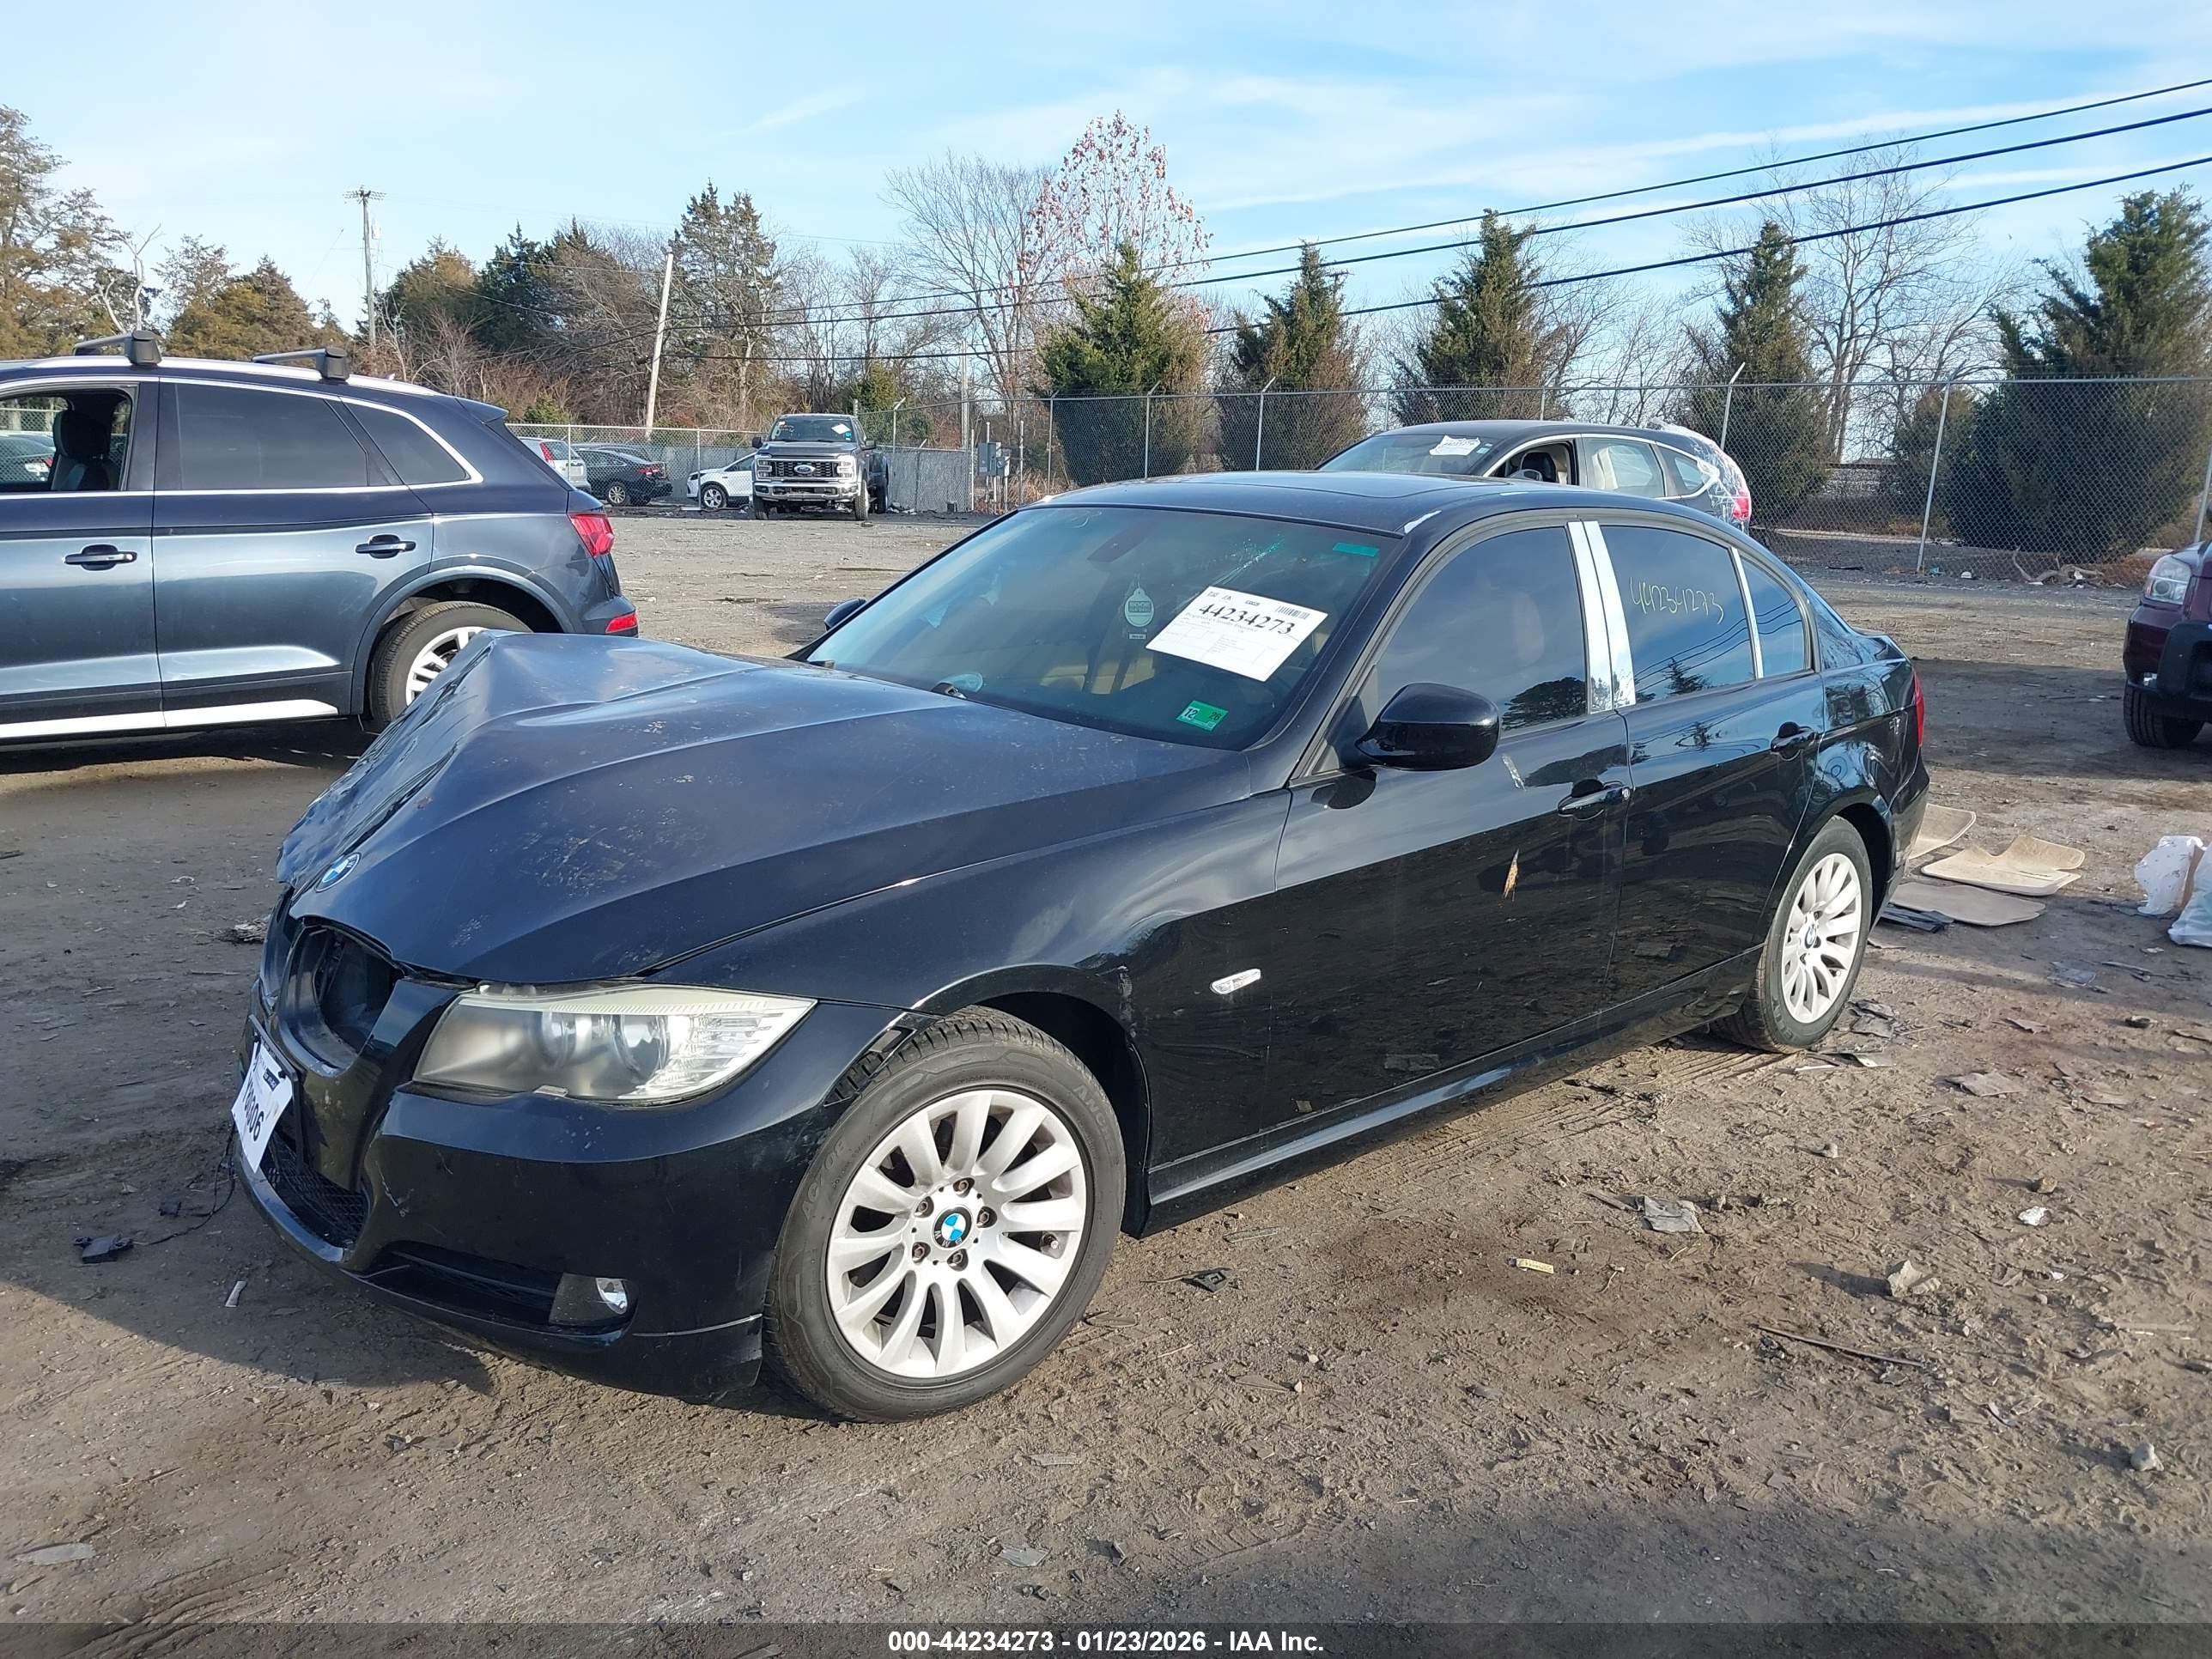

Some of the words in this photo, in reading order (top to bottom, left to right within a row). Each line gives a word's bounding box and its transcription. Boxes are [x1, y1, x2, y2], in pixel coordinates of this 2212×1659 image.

[1629, 576, 1724, 624] 44234273
[1199, 604, 1295, 635] 44234273
[1184, 708, 1199, 720] 12
[1209, 712, 1222, 721] 26
